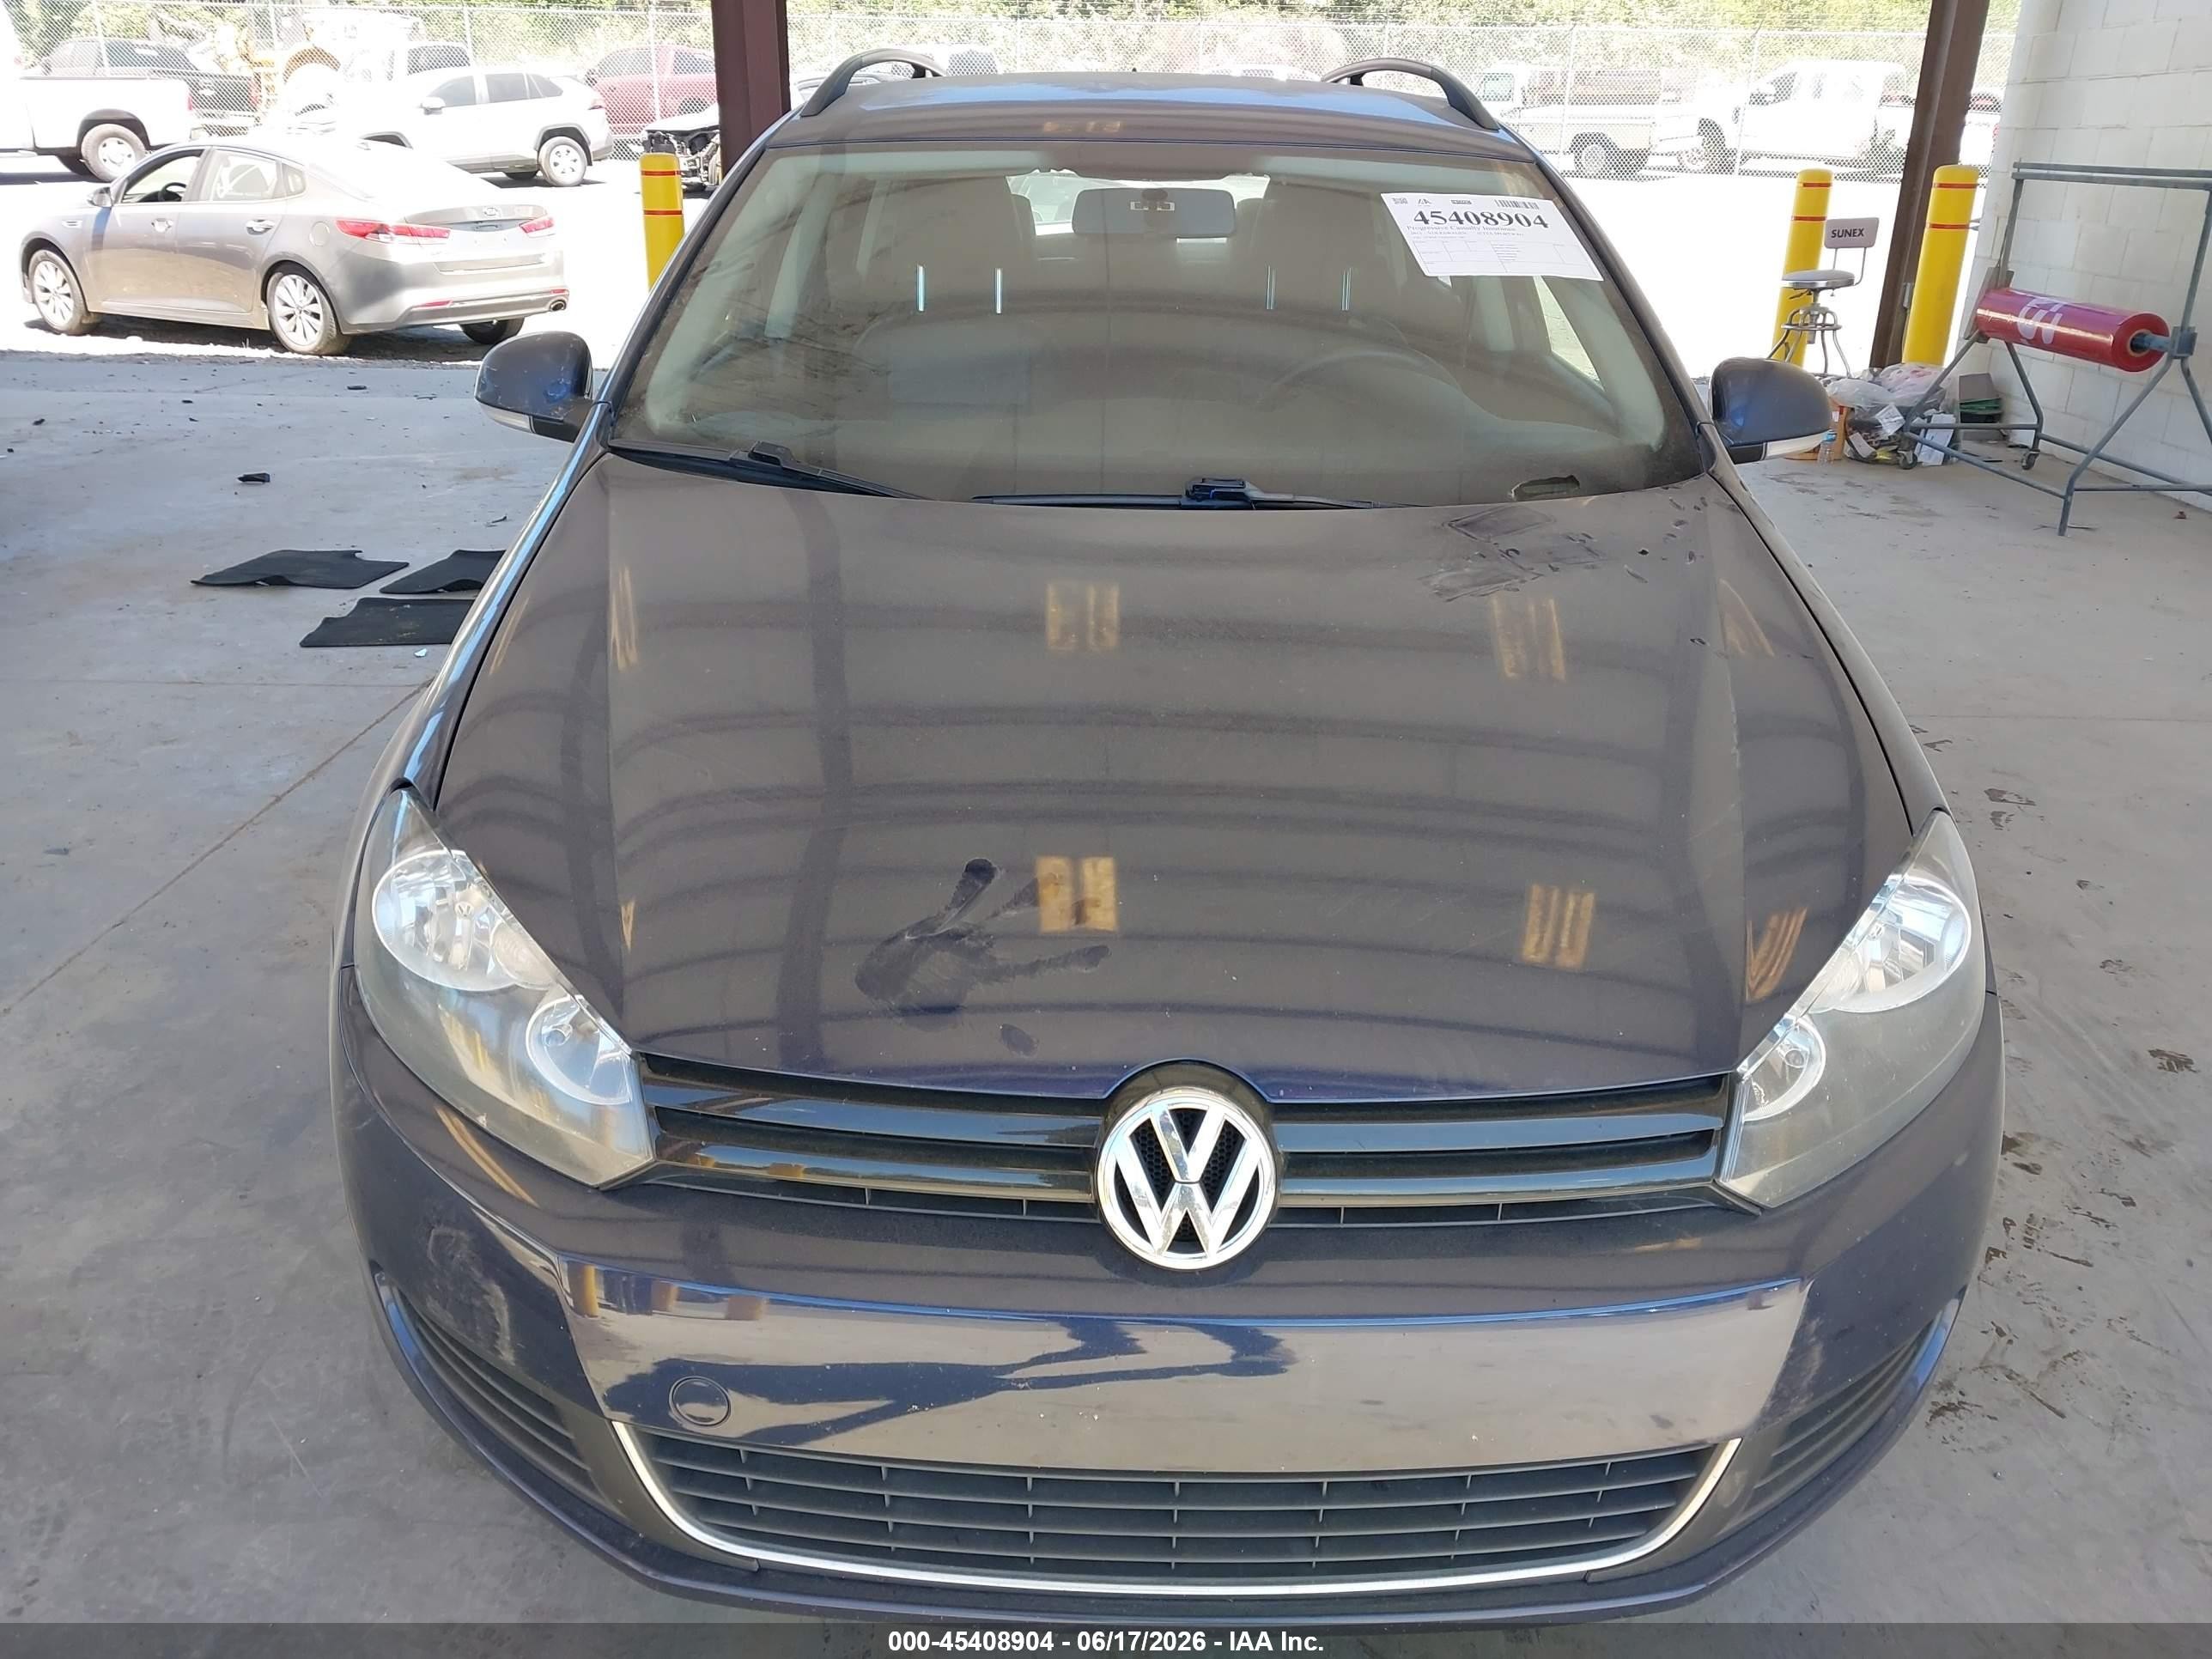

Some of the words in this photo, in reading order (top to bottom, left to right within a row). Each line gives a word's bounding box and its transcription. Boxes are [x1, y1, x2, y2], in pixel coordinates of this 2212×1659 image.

[1413, 210, 1549, 228] 45408904
[1831, 228, 1865, 239] SUNEX
[1101, 1093, 1272, 1265] VW
